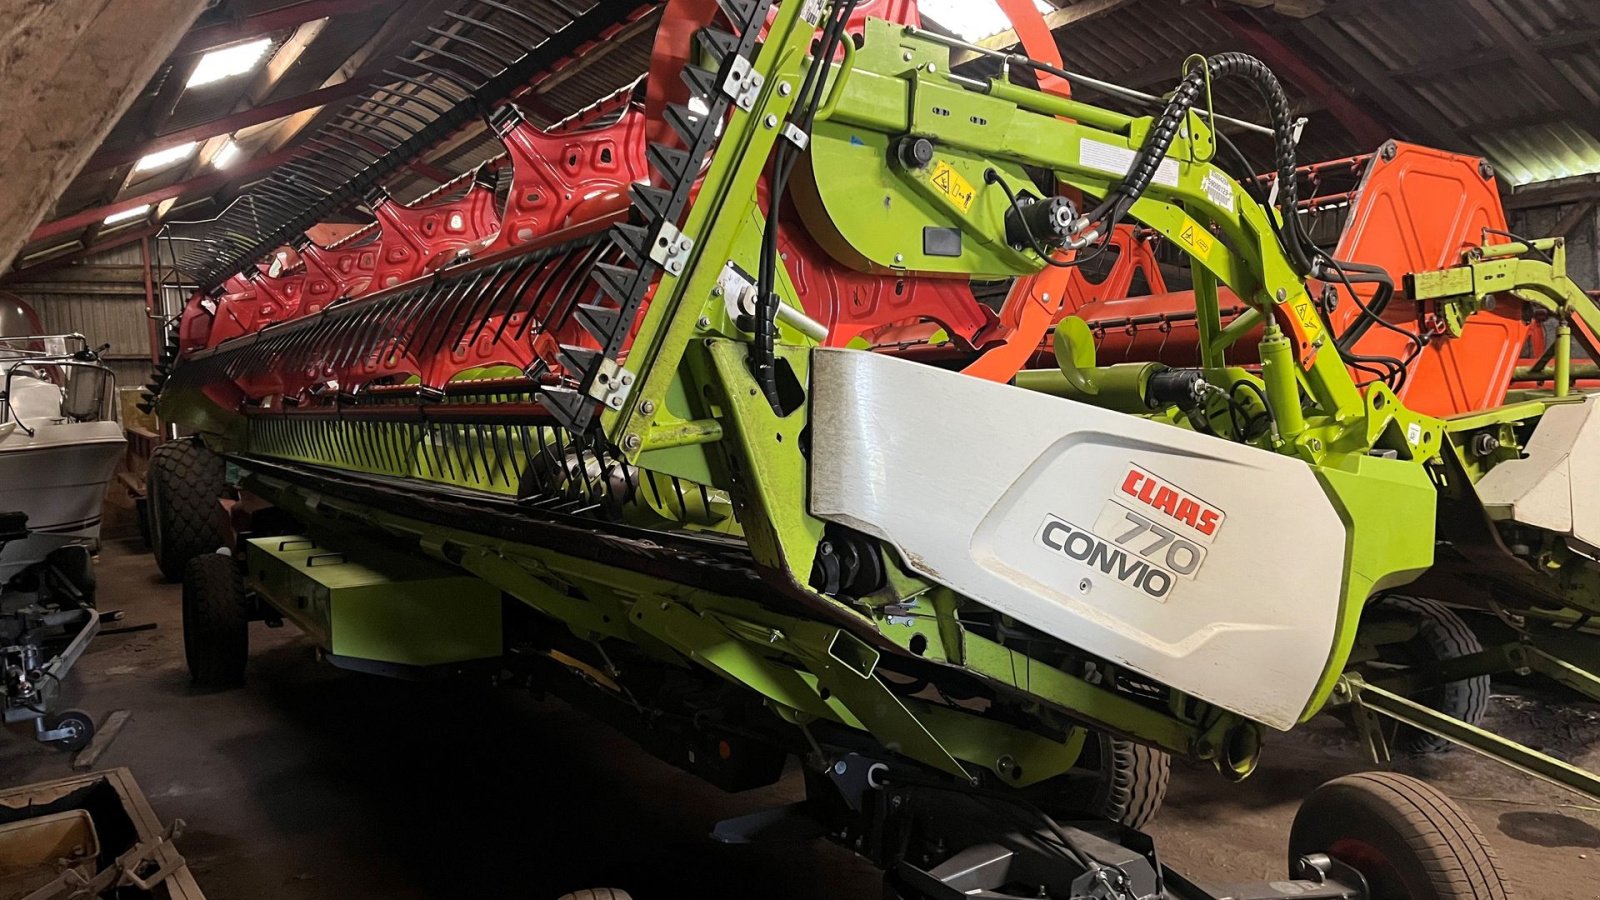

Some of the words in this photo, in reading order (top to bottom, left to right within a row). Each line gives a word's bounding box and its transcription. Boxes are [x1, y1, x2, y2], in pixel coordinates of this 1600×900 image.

[1121, 469, 1220, 536] CLAAS
[1041, 521, 1172, 598] CONVIO
[1114, 512, 1201, 576] 770
